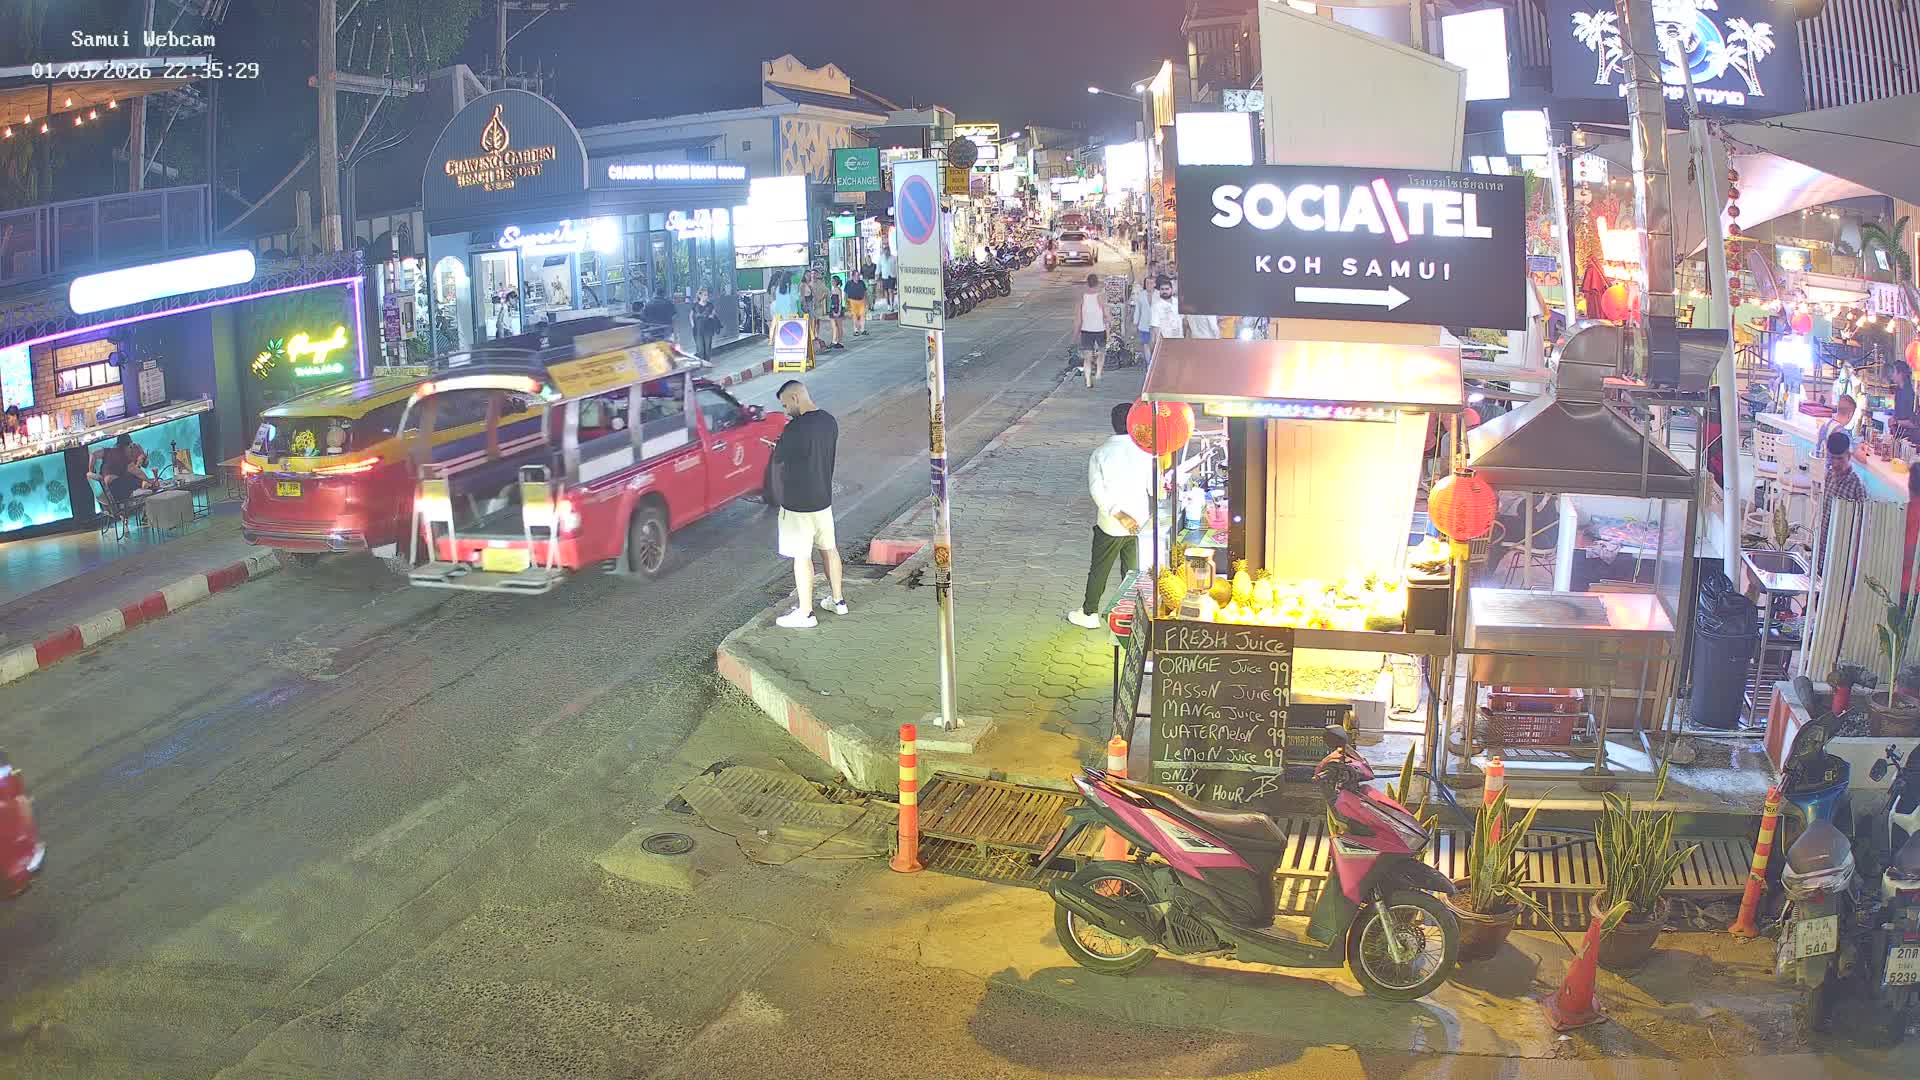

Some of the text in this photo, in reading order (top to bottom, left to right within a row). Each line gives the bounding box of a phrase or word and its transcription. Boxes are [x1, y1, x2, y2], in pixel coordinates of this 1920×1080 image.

[837, 175, 878, 186] EXCHANGE
[1255, 255, 1450, 281] KOH SAMUI
[904, 285, 936, 296] NO PARKING
[1165, 626, 1228, 651] FRESH
[1158, 654, 1221, 677] ORANGE
[1269, 661, 1290, 686] 99
[1272, 687, 1290, 707] 99
[1269, 709, 1288, 728] 99
[1267, 727, 1286, 747] 99
[1264, 748, 1284, 768] 99
[1889, 972, 1917, 983] 5239
